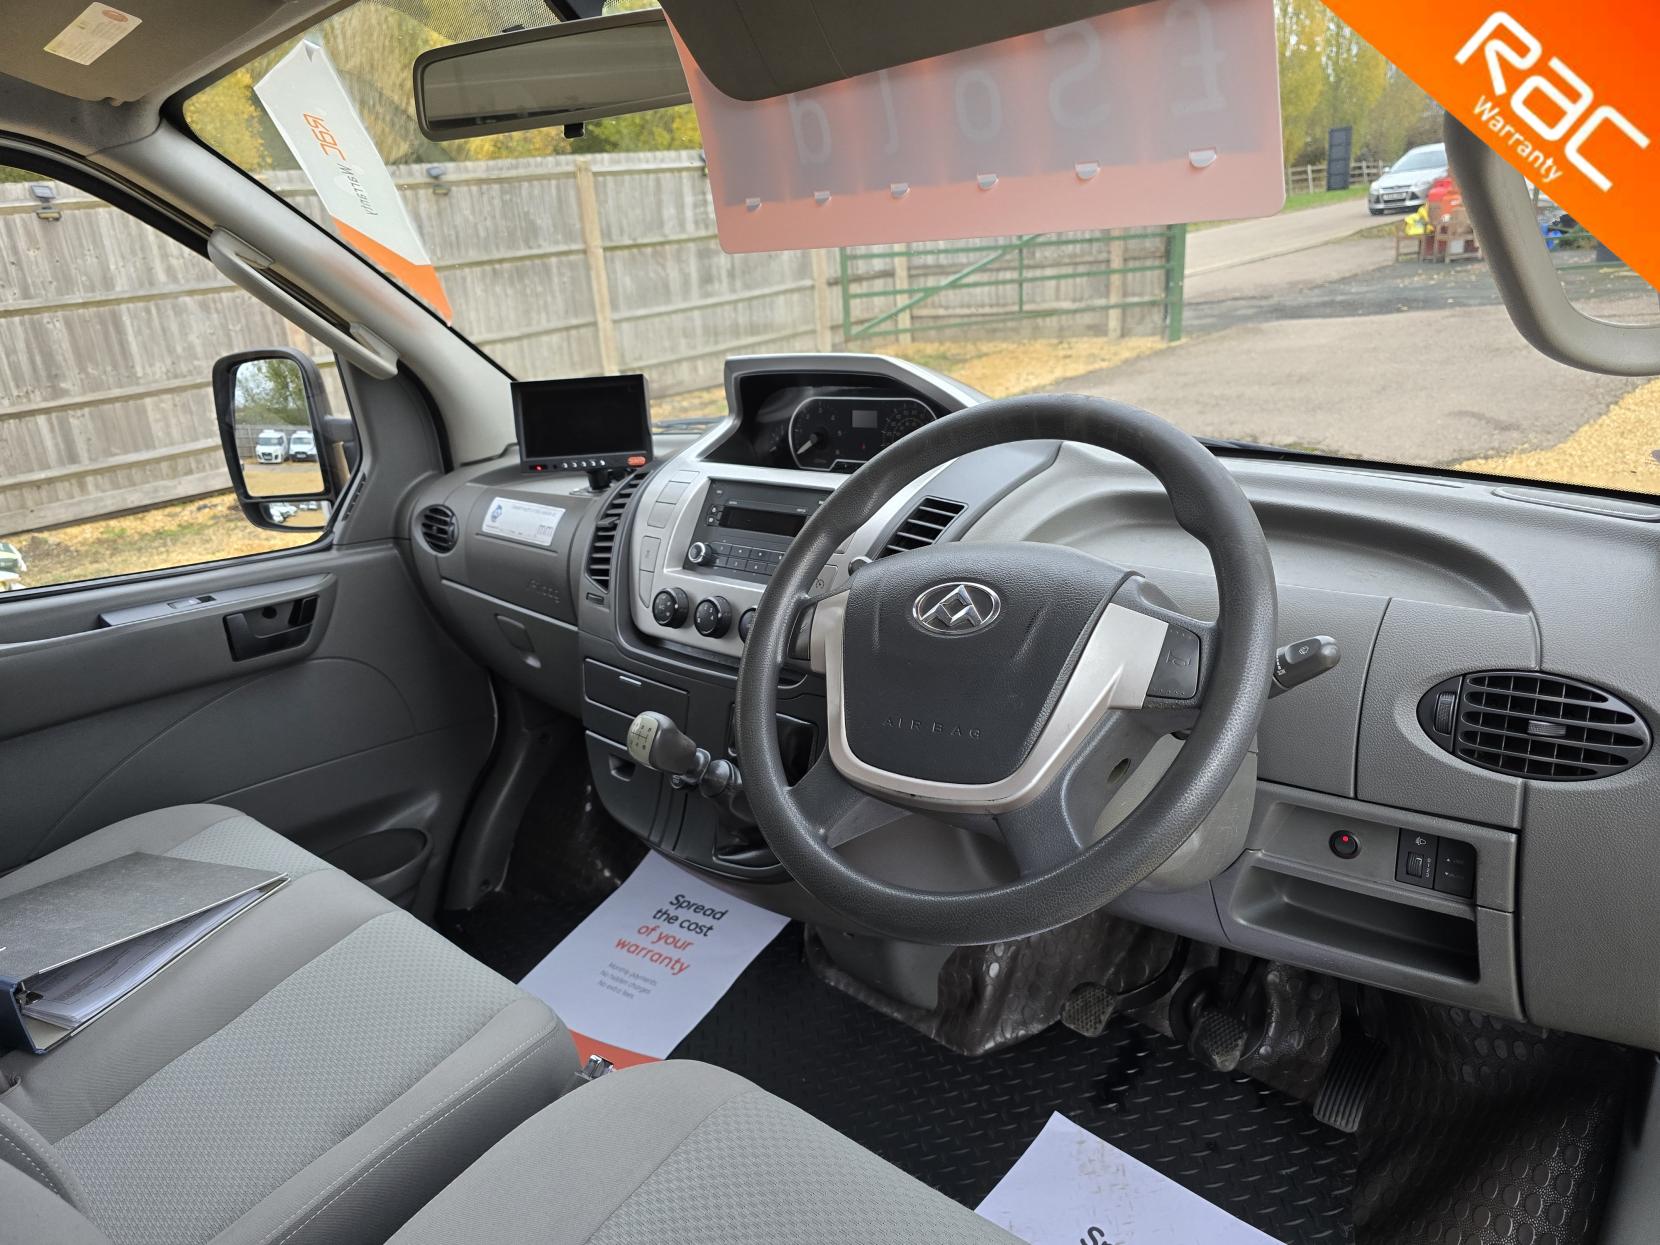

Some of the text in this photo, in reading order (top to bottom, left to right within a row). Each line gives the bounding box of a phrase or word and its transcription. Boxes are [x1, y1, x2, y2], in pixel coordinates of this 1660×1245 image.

[668, 894, 729, 920] Spread
[652, 907, 714, 937] the cost
[636, 924, 694, 951] of your
[615, 938, 691, 976] warranty
